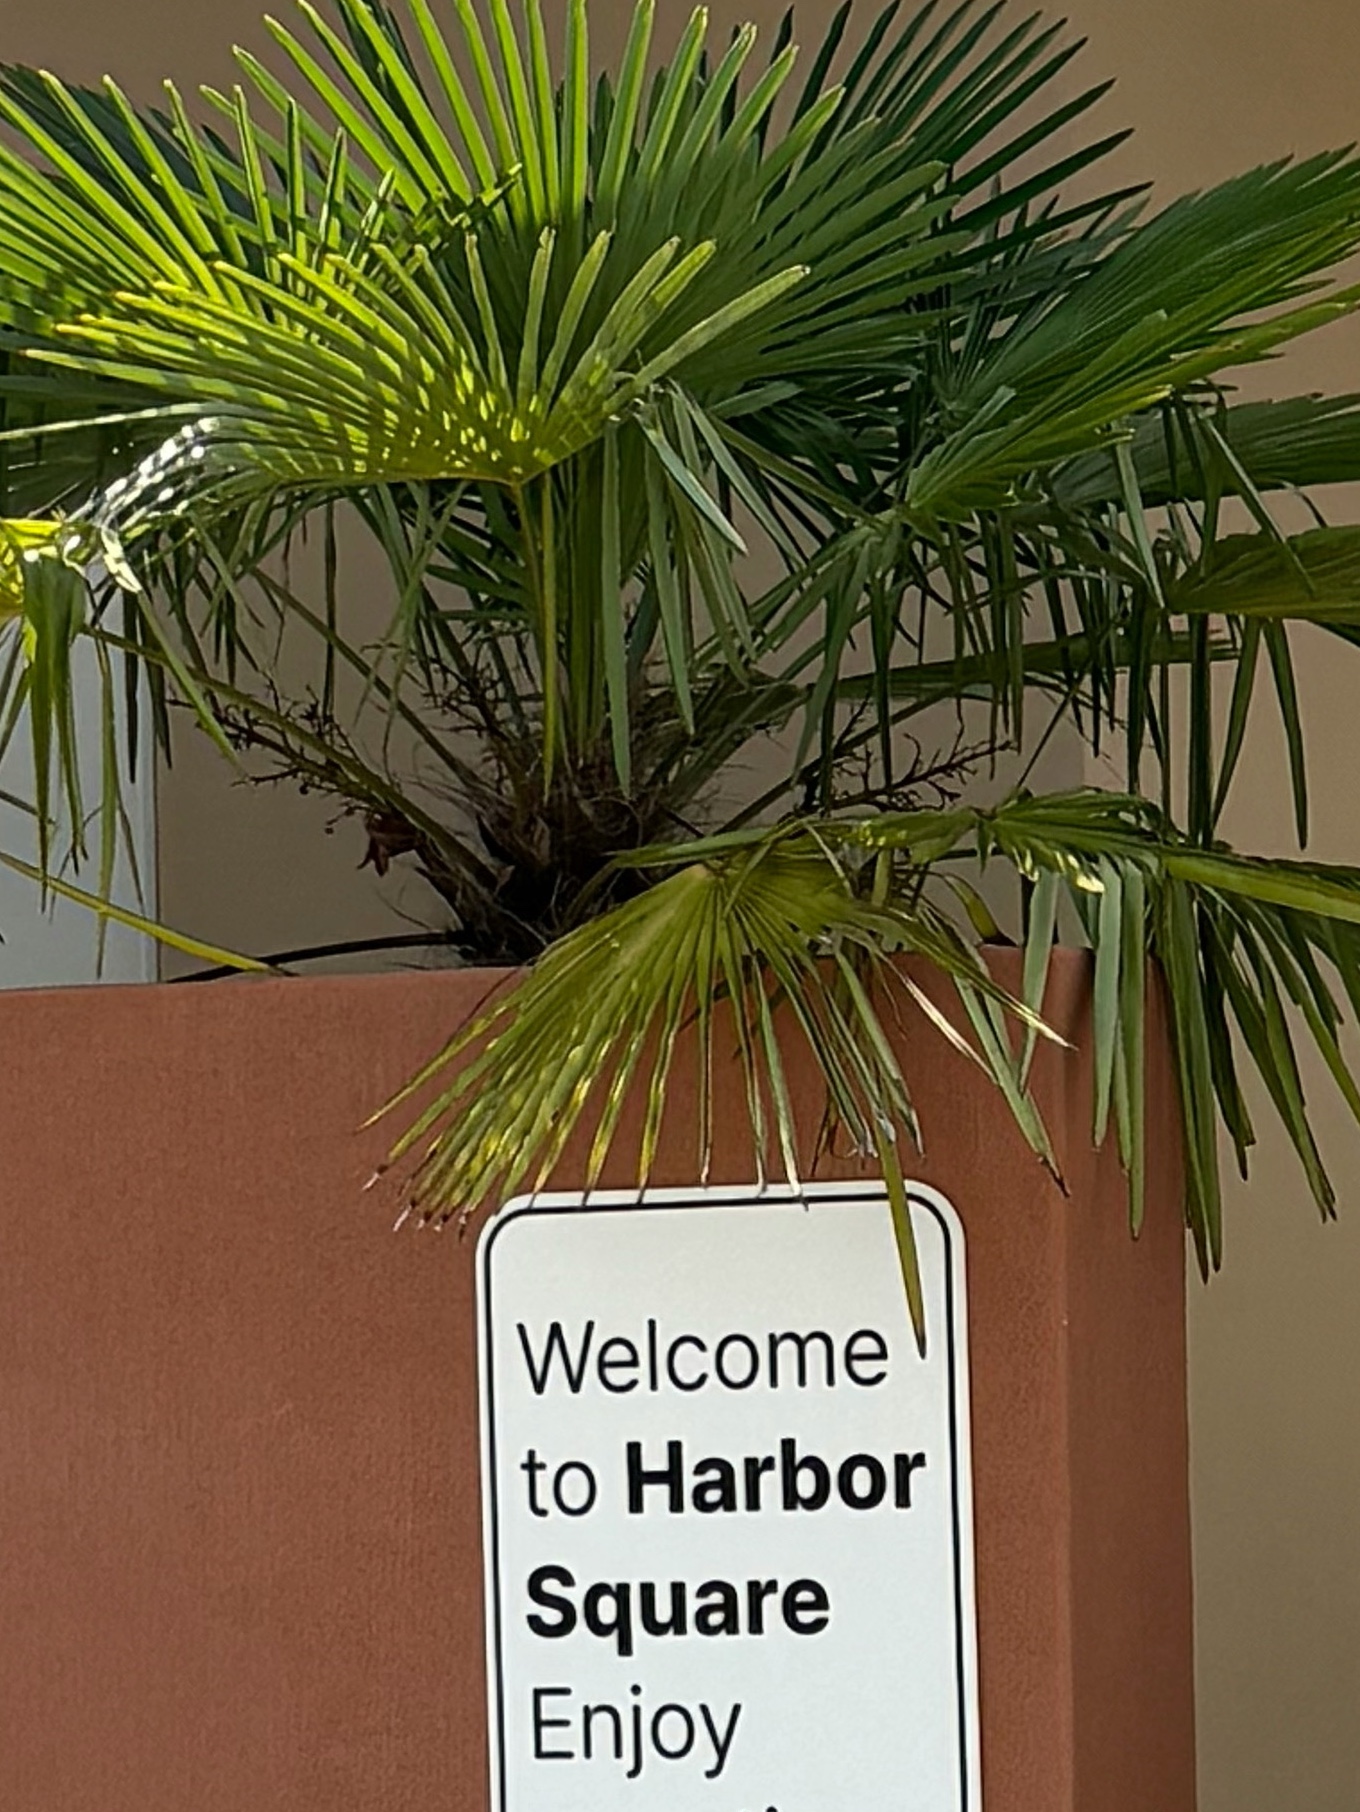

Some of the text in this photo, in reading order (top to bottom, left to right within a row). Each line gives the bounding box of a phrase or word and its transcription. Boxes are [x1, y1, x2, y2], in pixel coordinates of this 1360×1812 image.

[516, 1318, 889, 1396] Welcome
[520, 1437, 927, 1518] to Harbor
[526, 1564, 830, 1657] Square
[532, 1684, 742, 1779] Enjoy
